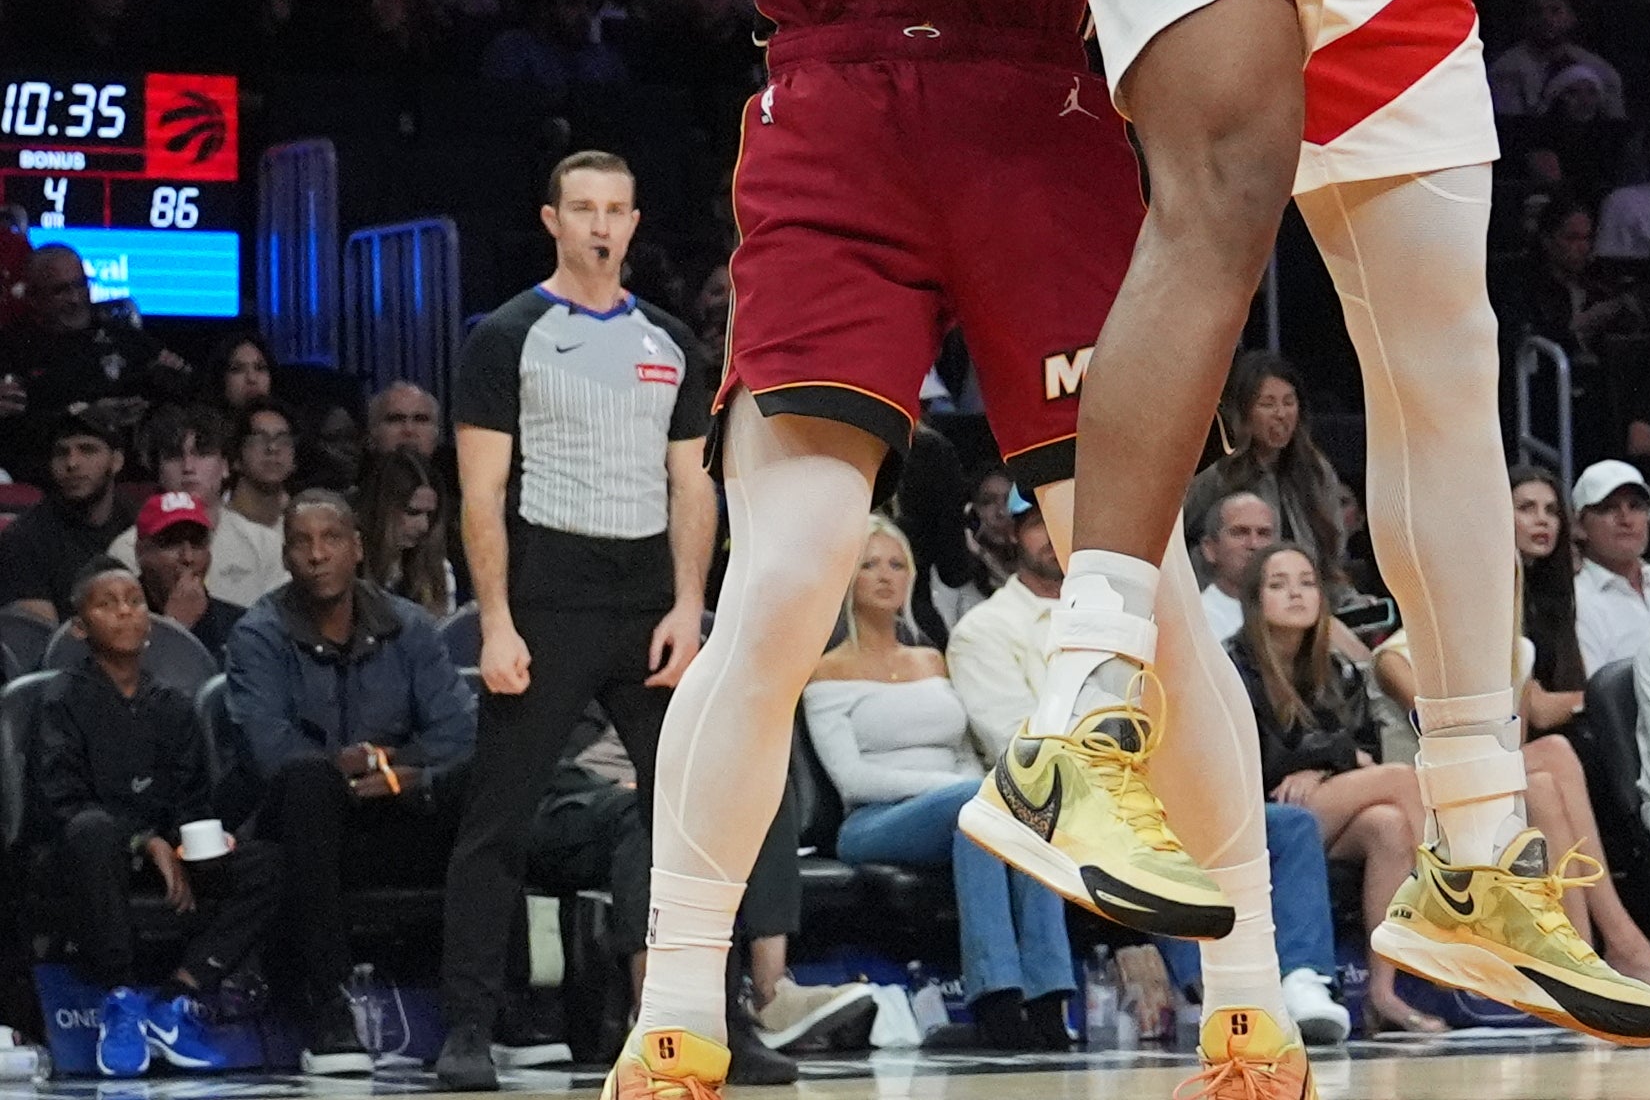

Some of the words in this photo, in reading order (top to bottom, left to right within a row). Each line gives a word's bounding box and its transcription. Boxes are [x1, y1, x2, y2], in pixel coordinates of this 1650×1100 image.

[1, 81, 127, 139] 10:35
[19, 149, 86, 171] BONUS
[43, 176, 69, 213] 4
[149, 186, 200, 229] 86
